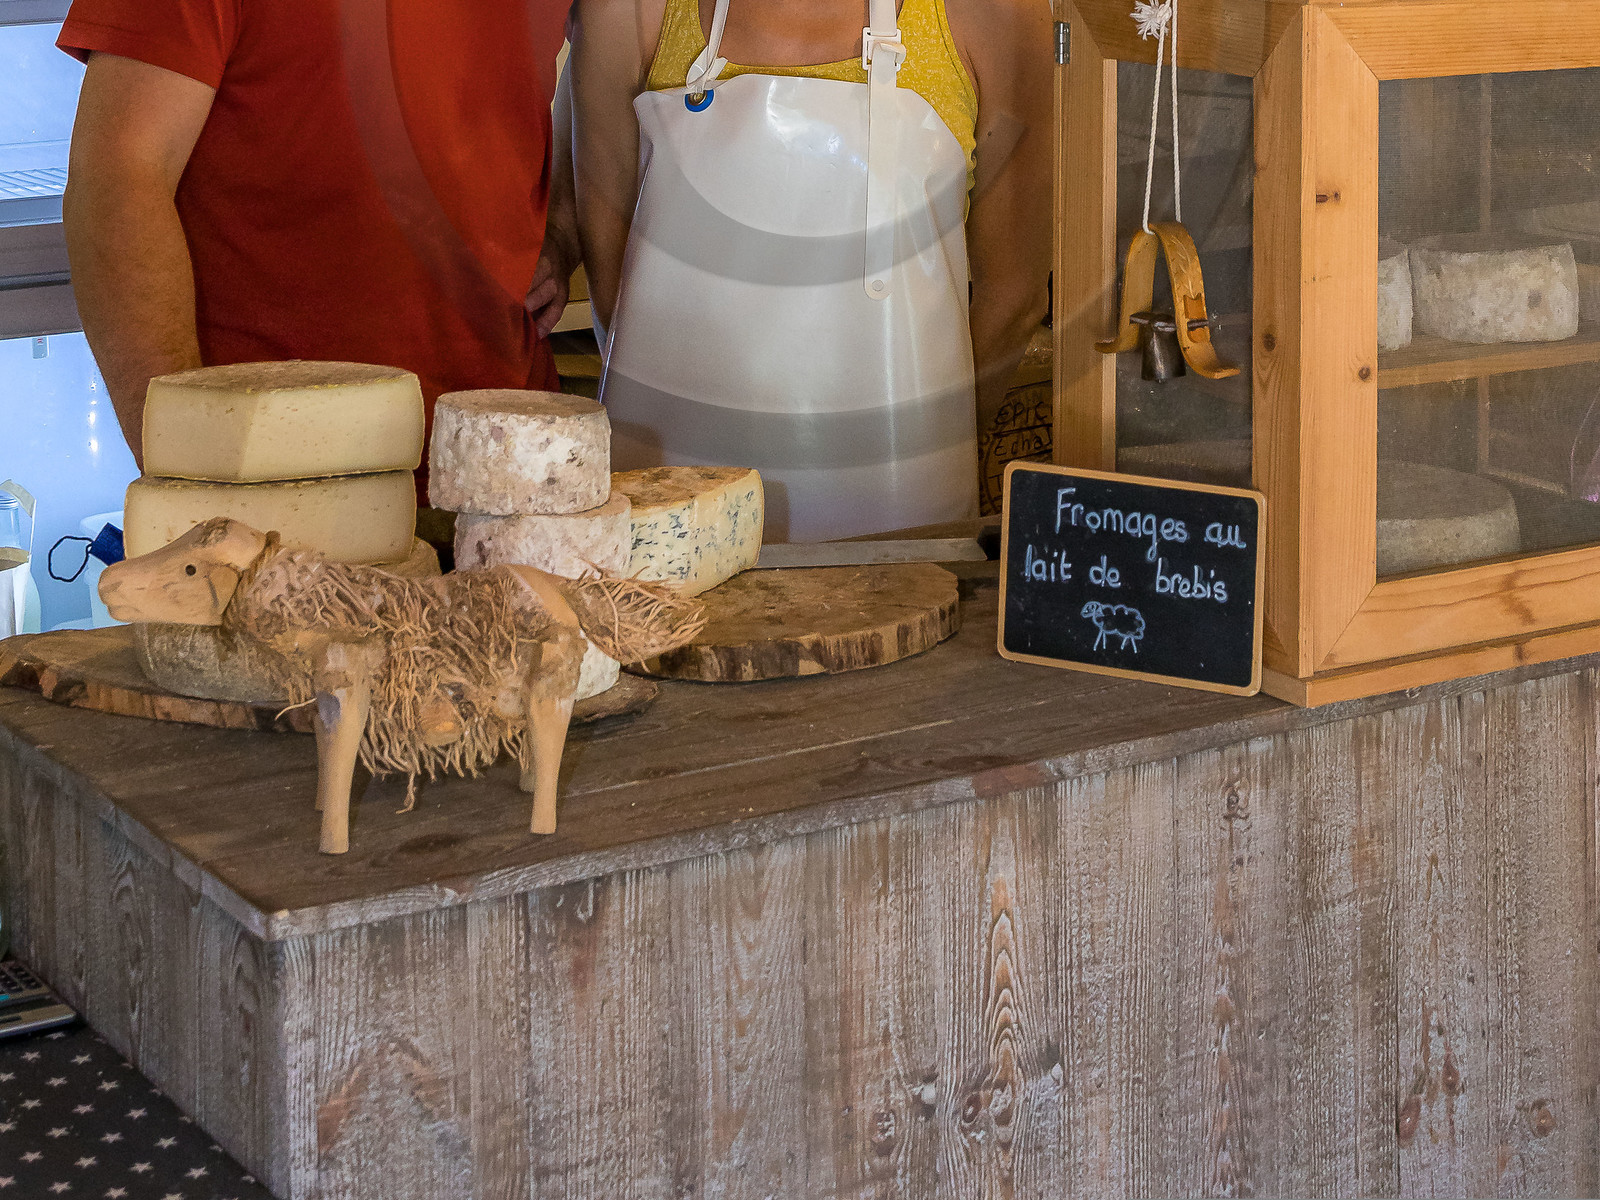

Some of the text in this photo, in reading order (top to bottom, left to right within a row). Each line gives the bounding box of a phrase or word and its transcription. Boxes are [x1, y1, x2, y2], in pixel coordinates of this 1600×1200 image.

[1055, 487, 1247, 562] Fromages au
[1024, 544, 1228, 603] lait de brebis
